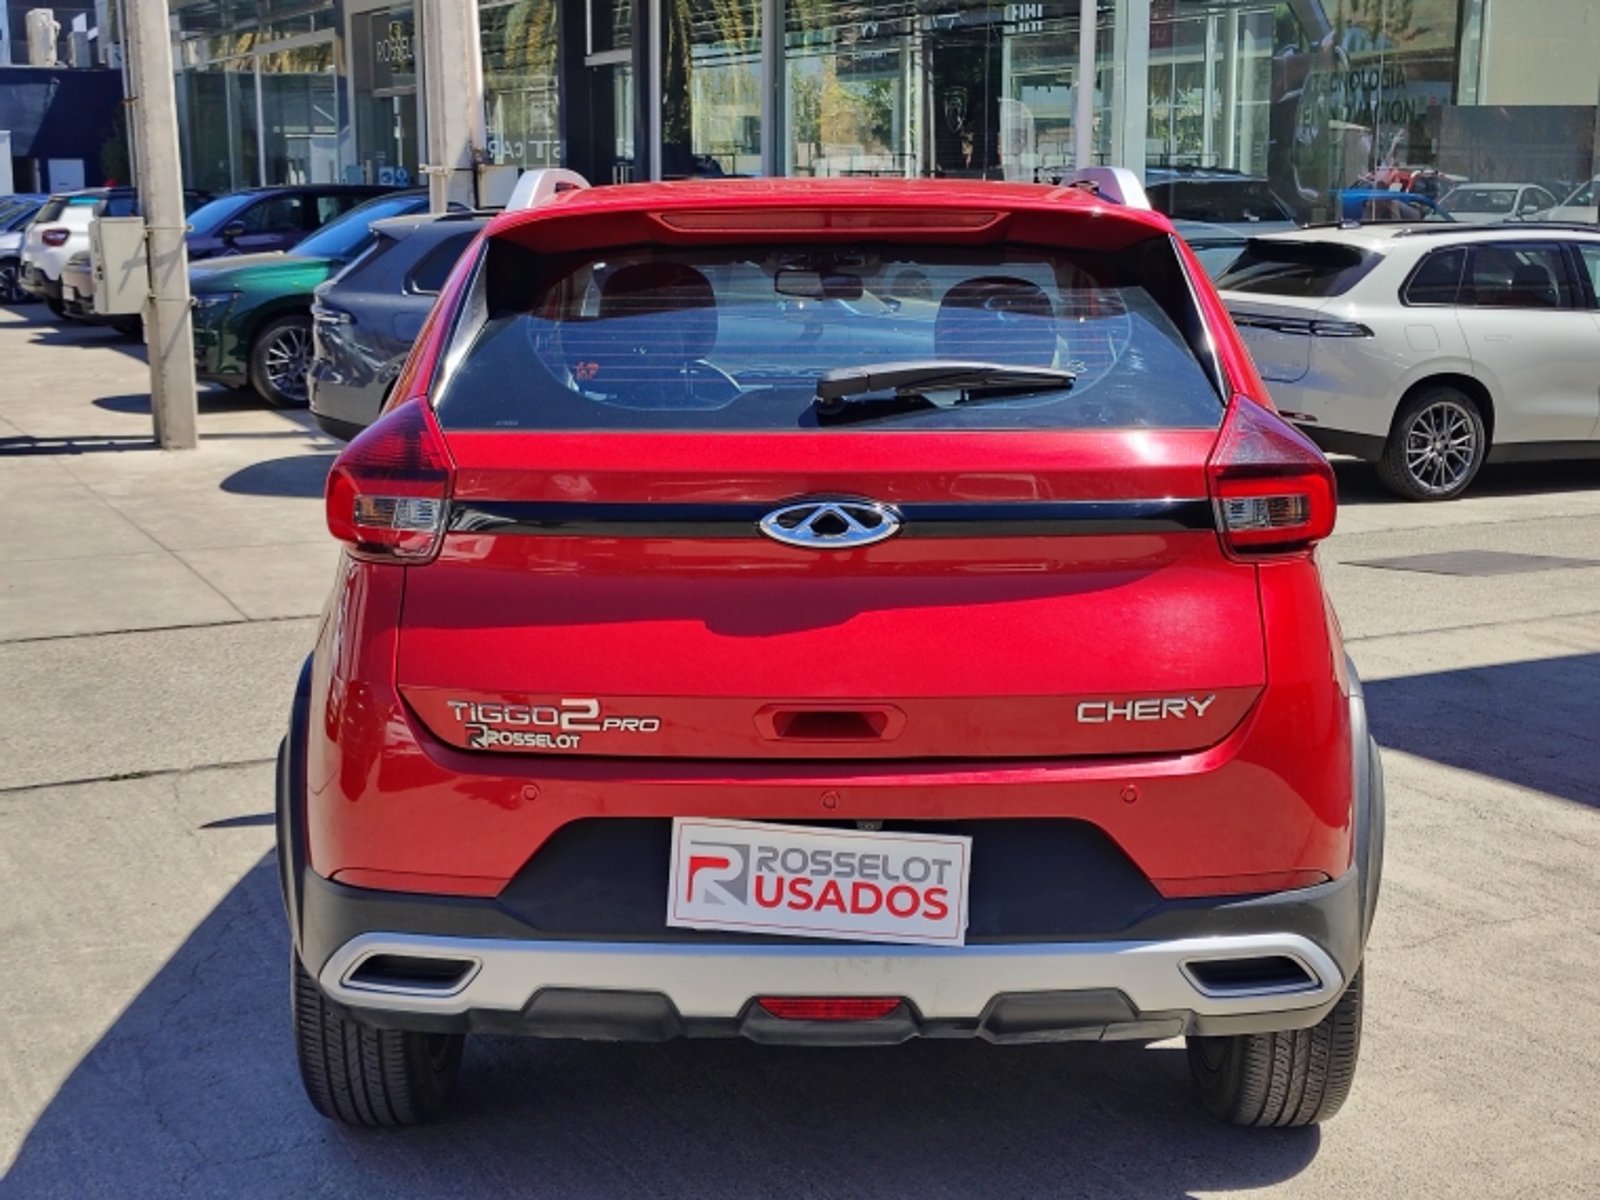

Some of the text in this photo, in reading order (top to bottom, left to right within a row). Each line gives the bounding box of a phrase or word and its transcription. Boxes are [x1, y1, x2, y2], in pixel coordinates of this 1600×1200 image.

[447, 700, 559, 725] TIGGO
[602, 718, 660, 732] PRO
[1077, 694, 1216, 723] CHERY
[755, 846, 952, 885] ROSSELOT
[754, 875, 949, 921] USADOS
